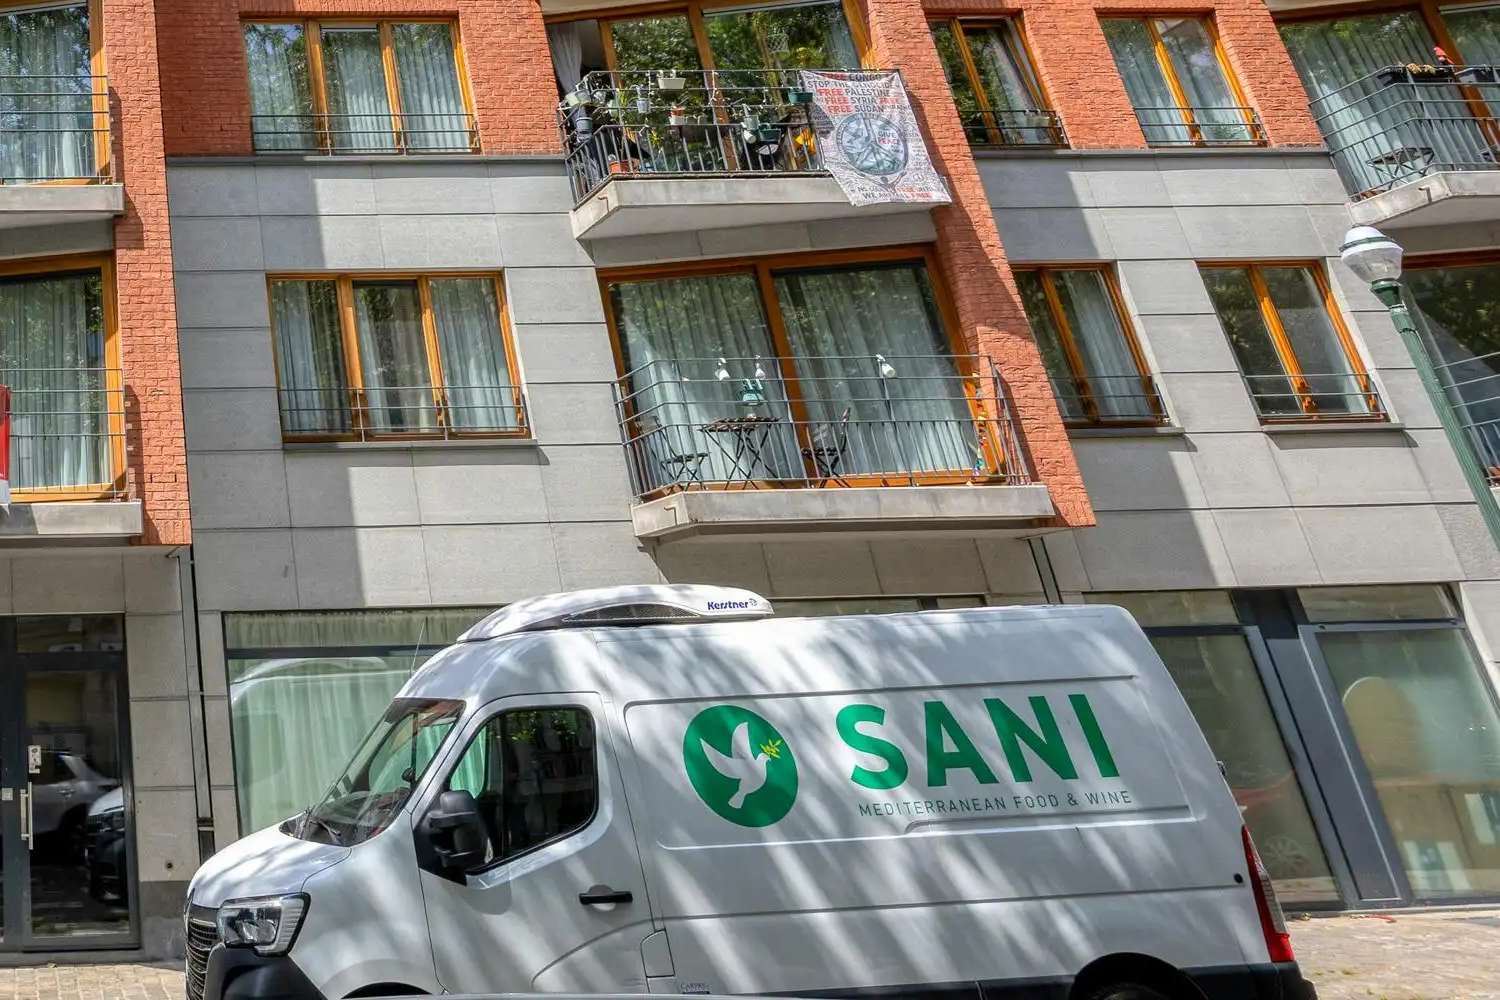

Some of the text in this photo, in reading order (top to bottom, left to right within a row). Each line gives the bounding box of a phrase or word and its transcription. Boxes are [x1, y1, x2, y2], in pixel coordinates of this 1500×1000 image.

[807, 80, 830, 89] STOP
[817, 88, 890, 97] FREE PALESTINE
[825, 96, 849, 104] FREE
[850, 96, 877, 104] SYRIA
[827, 105, 852, 113] FREE
[854, 105, 884, 113] SUDAN
[707, 600, 749, 611] Kerstner
[835, 693, 1121, 791] SANI
[858, 790, 1132, 817] MEDITERRANEAN FOOD & WINE
